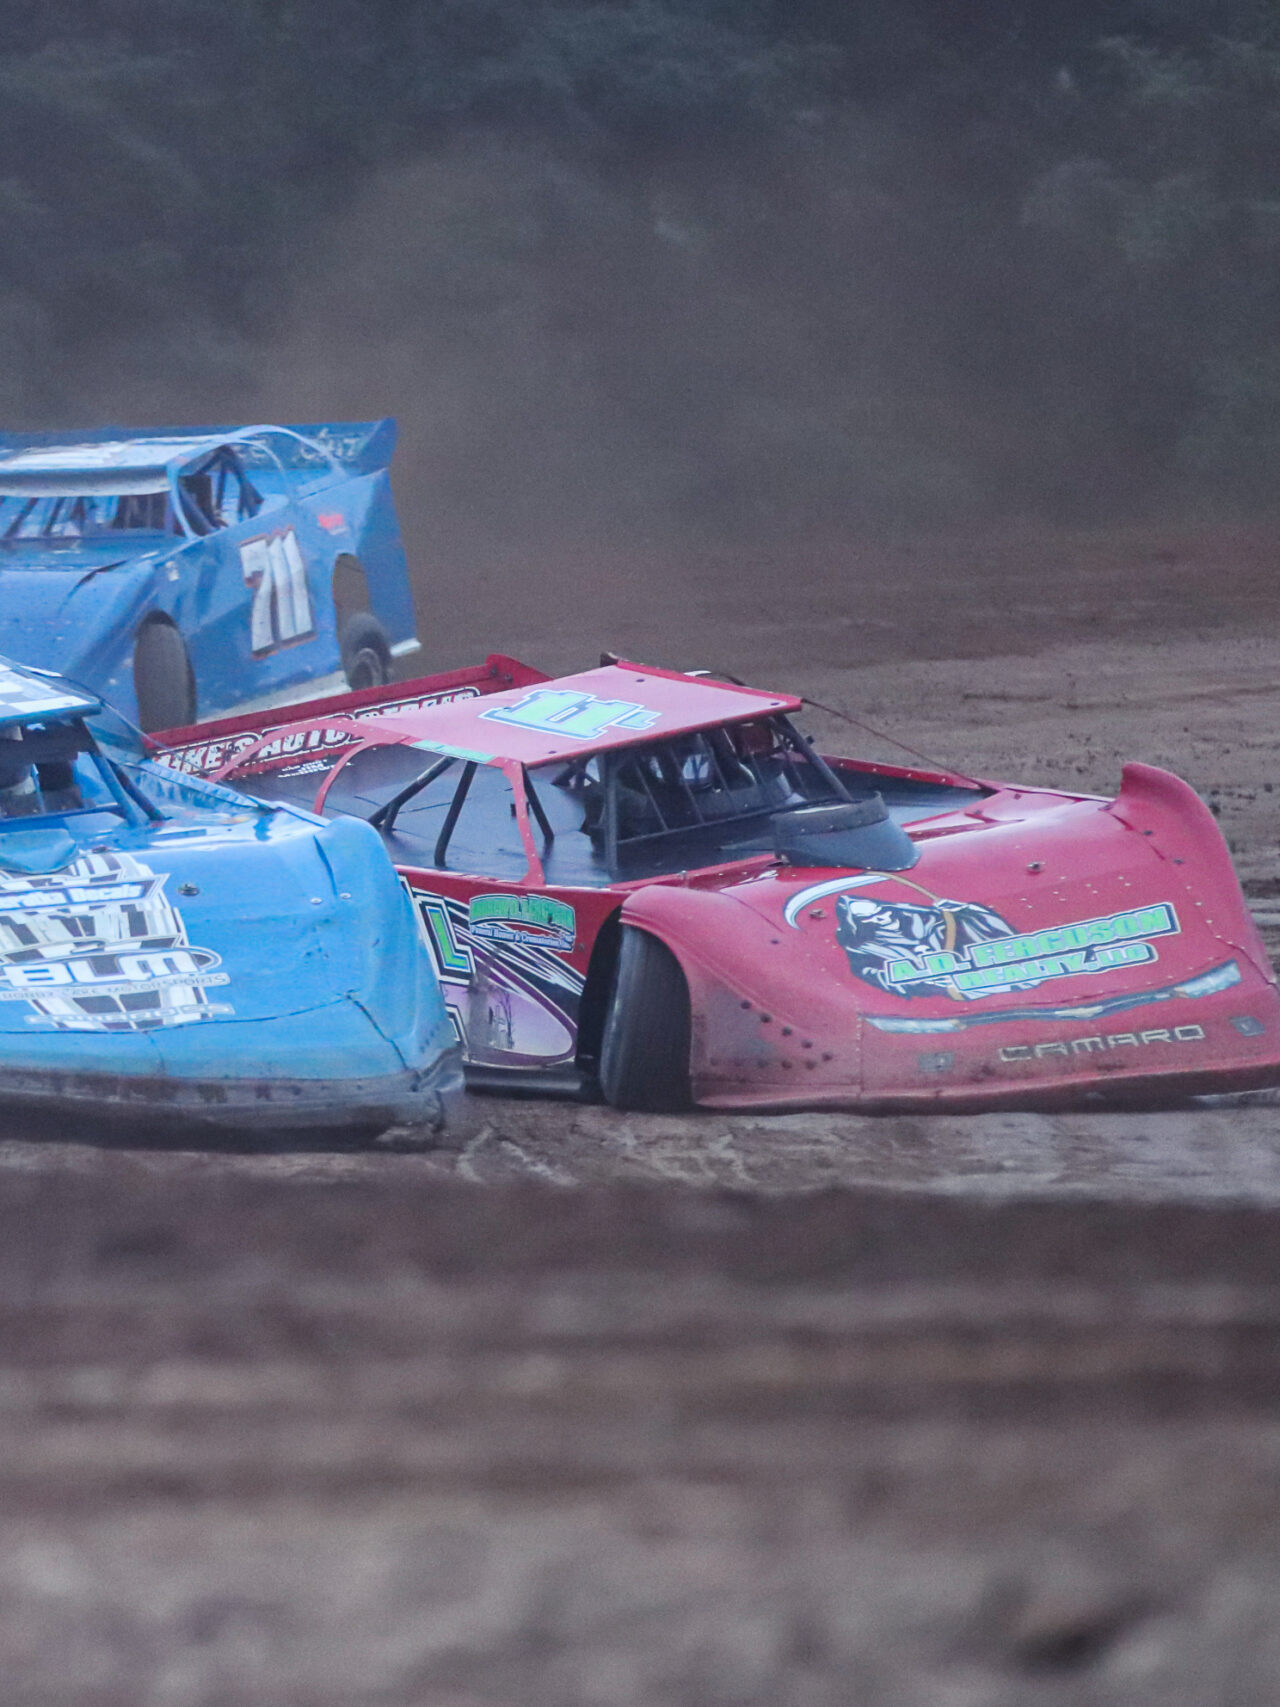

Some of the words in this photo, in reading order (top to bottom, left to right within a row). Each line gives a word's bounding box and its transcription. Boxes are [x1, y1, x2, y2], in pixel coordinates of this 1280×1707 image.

[971, 907, 1171, 967] FERGUSON
[0, 951, 200, 987] BLM
[998, 1024, 1205, 1062] CAMARO
